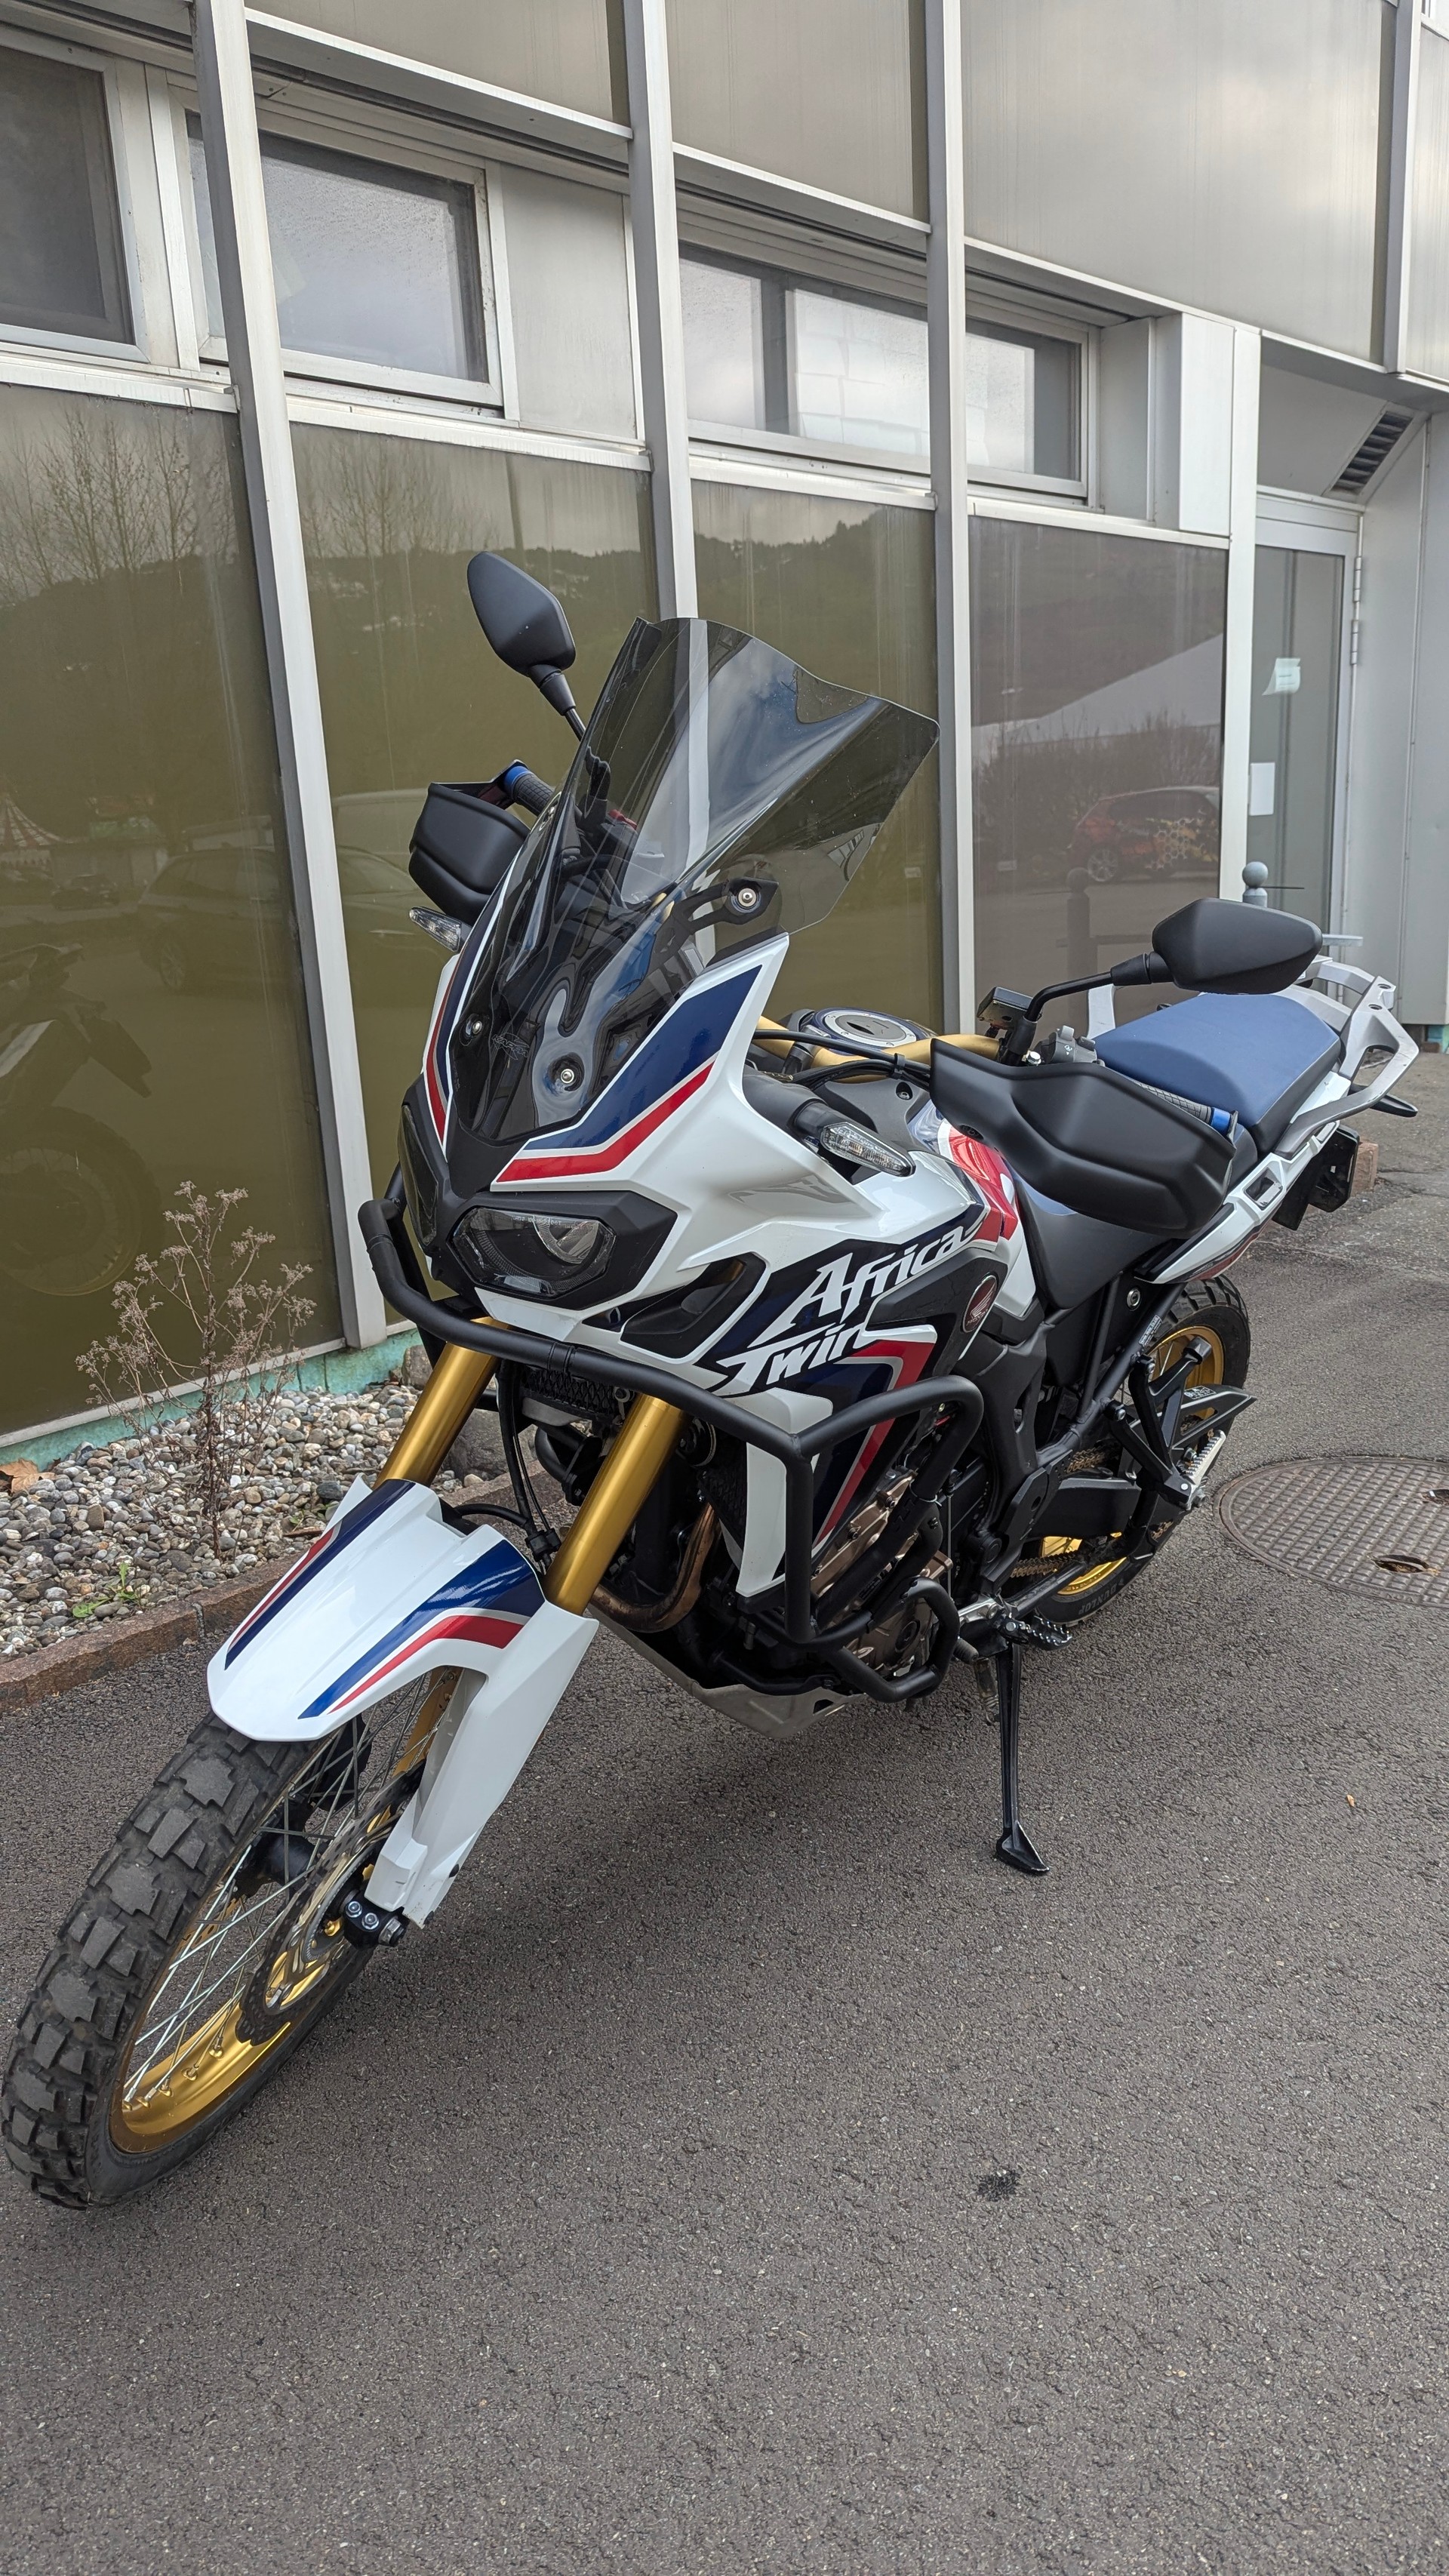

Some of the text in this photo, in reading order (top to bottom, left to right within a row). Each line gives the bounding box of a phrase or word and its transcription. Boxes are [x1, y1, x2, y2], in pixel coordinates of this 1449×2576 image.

[746, 1224, 980, 1349] Africa
[712, 1322, 875, 1396] Twin
[1078, 1584, 1118, 1615] DUNLOP
